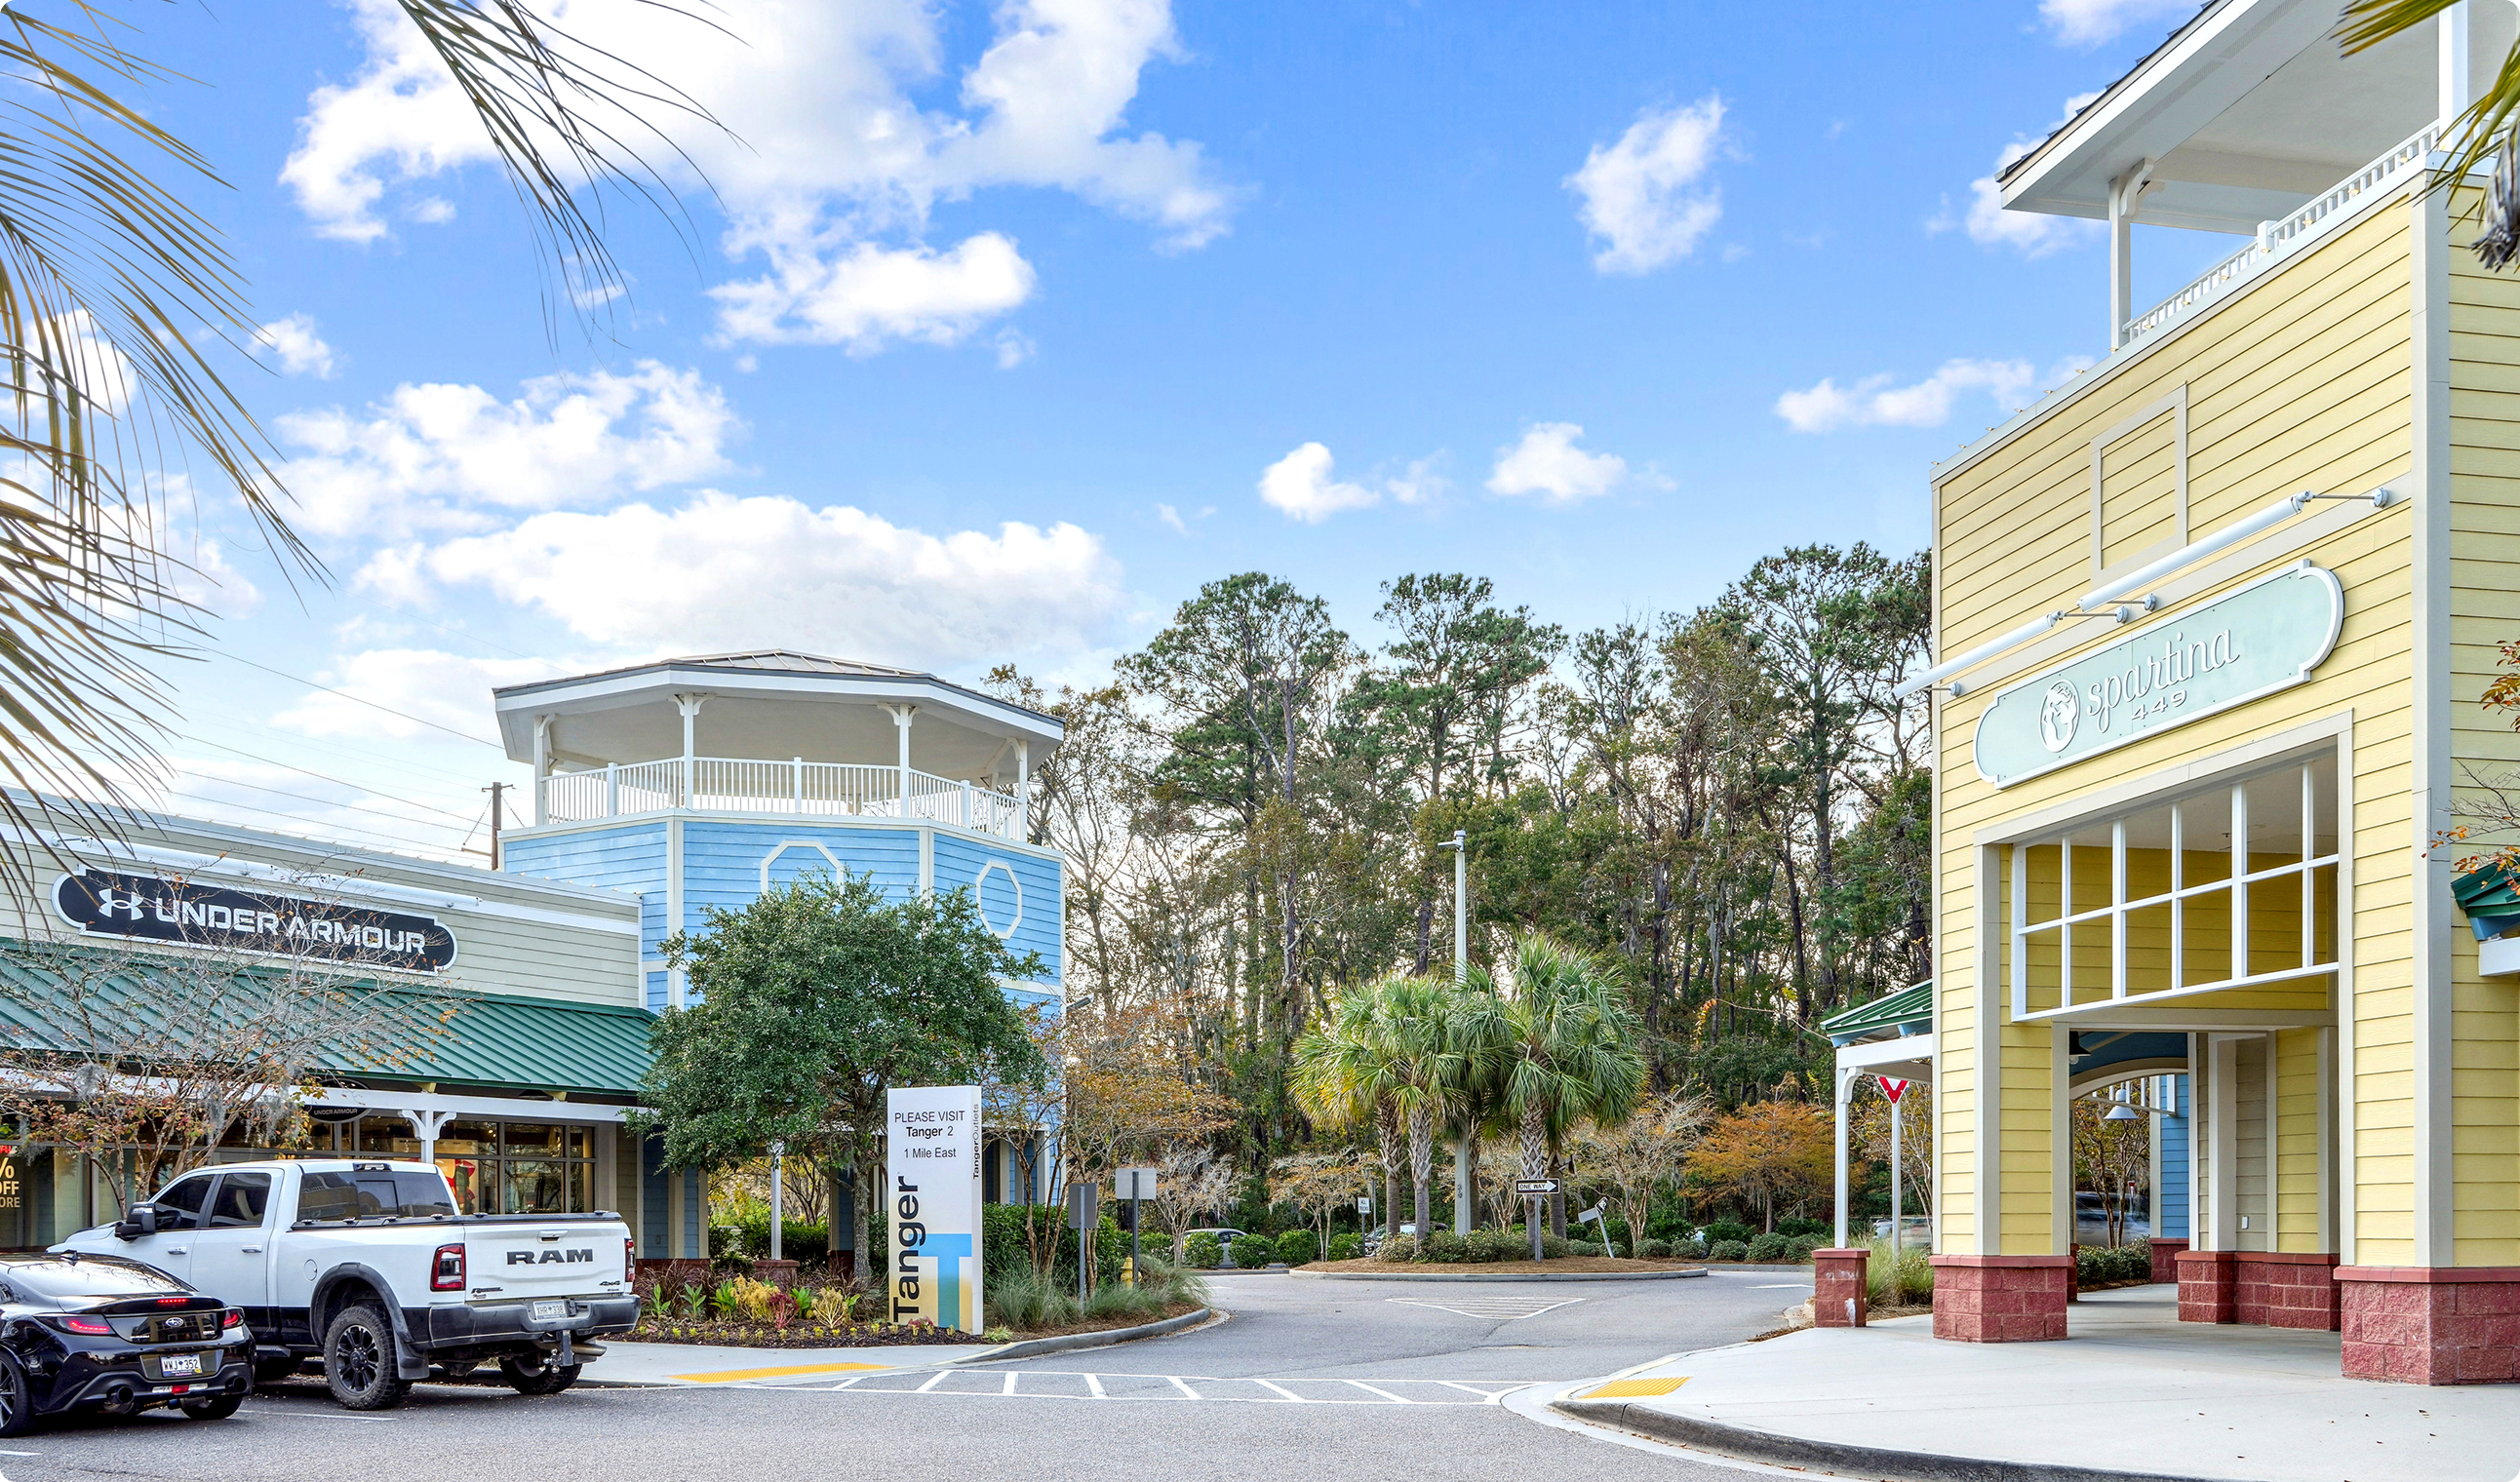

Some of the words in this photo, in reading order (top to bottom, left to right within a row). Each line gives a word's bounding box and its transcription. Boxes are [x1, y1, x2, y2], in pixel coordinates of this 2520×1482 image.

[2087, 629, 2240, 733] spartina
[2132, 688, 2187, 721] 449
[155, 897, 279, 936] UNDER
[286, 916, 425, 956] ARMOUR
[894, 1112, 935, 1122] PLEASE
[938, 1111, 965, 1121] VISIT
[906, 1126, 943, 1139] Tanger
[947, 1125, 954, 1136] 2
[904, 1149, 909, 1158] 1
[912, 1149, 932, 1158] Mile
[934, 1147, 957, 1158] East
[0, 1181, 20, 1195] FF
[893, 1175, 926, 1323] Tanger
[507, 1249, 593, 1266] RAM
[184, 1359, 198, 1369] 352
